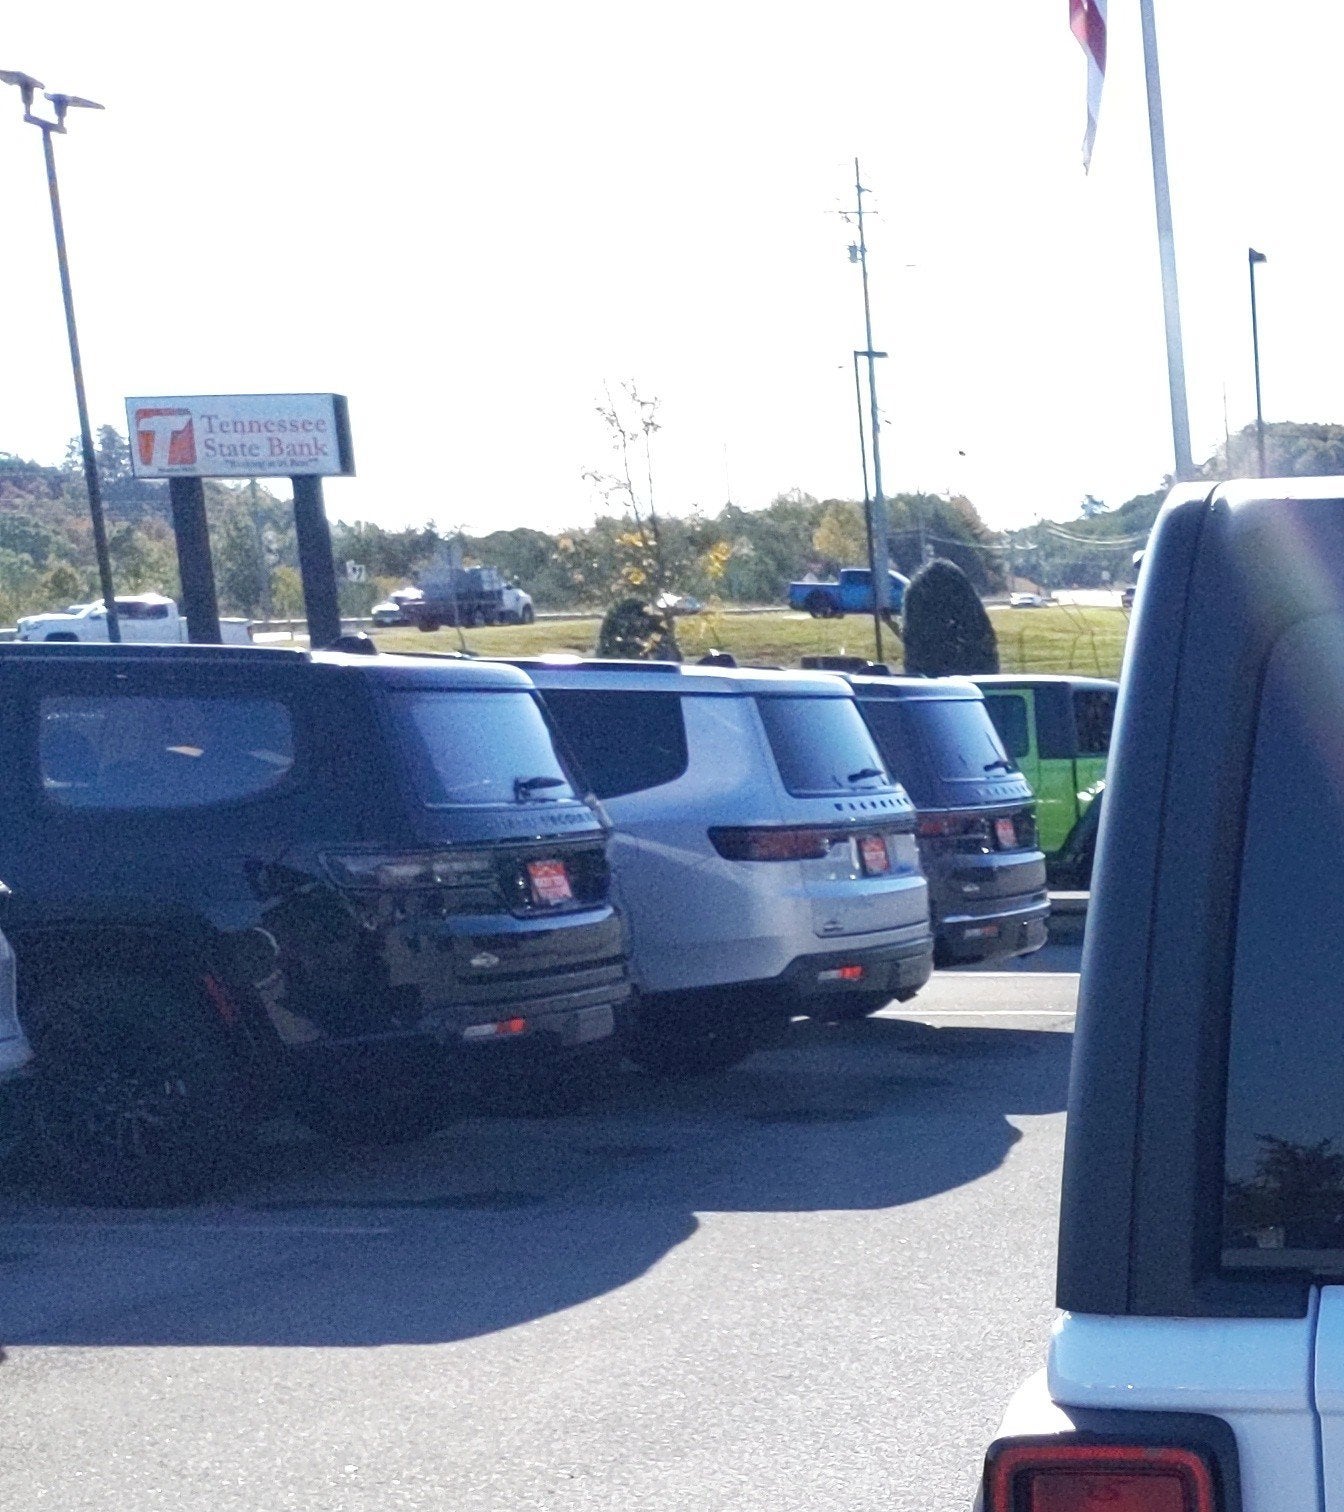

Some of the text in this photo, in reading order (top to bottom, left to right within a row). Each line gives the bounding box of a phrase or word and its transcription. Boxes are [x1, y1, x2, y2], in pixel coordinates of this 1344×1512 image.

[201, 414, 327, 434] Tennessee
[204, 437, 328, 457] State Bank
